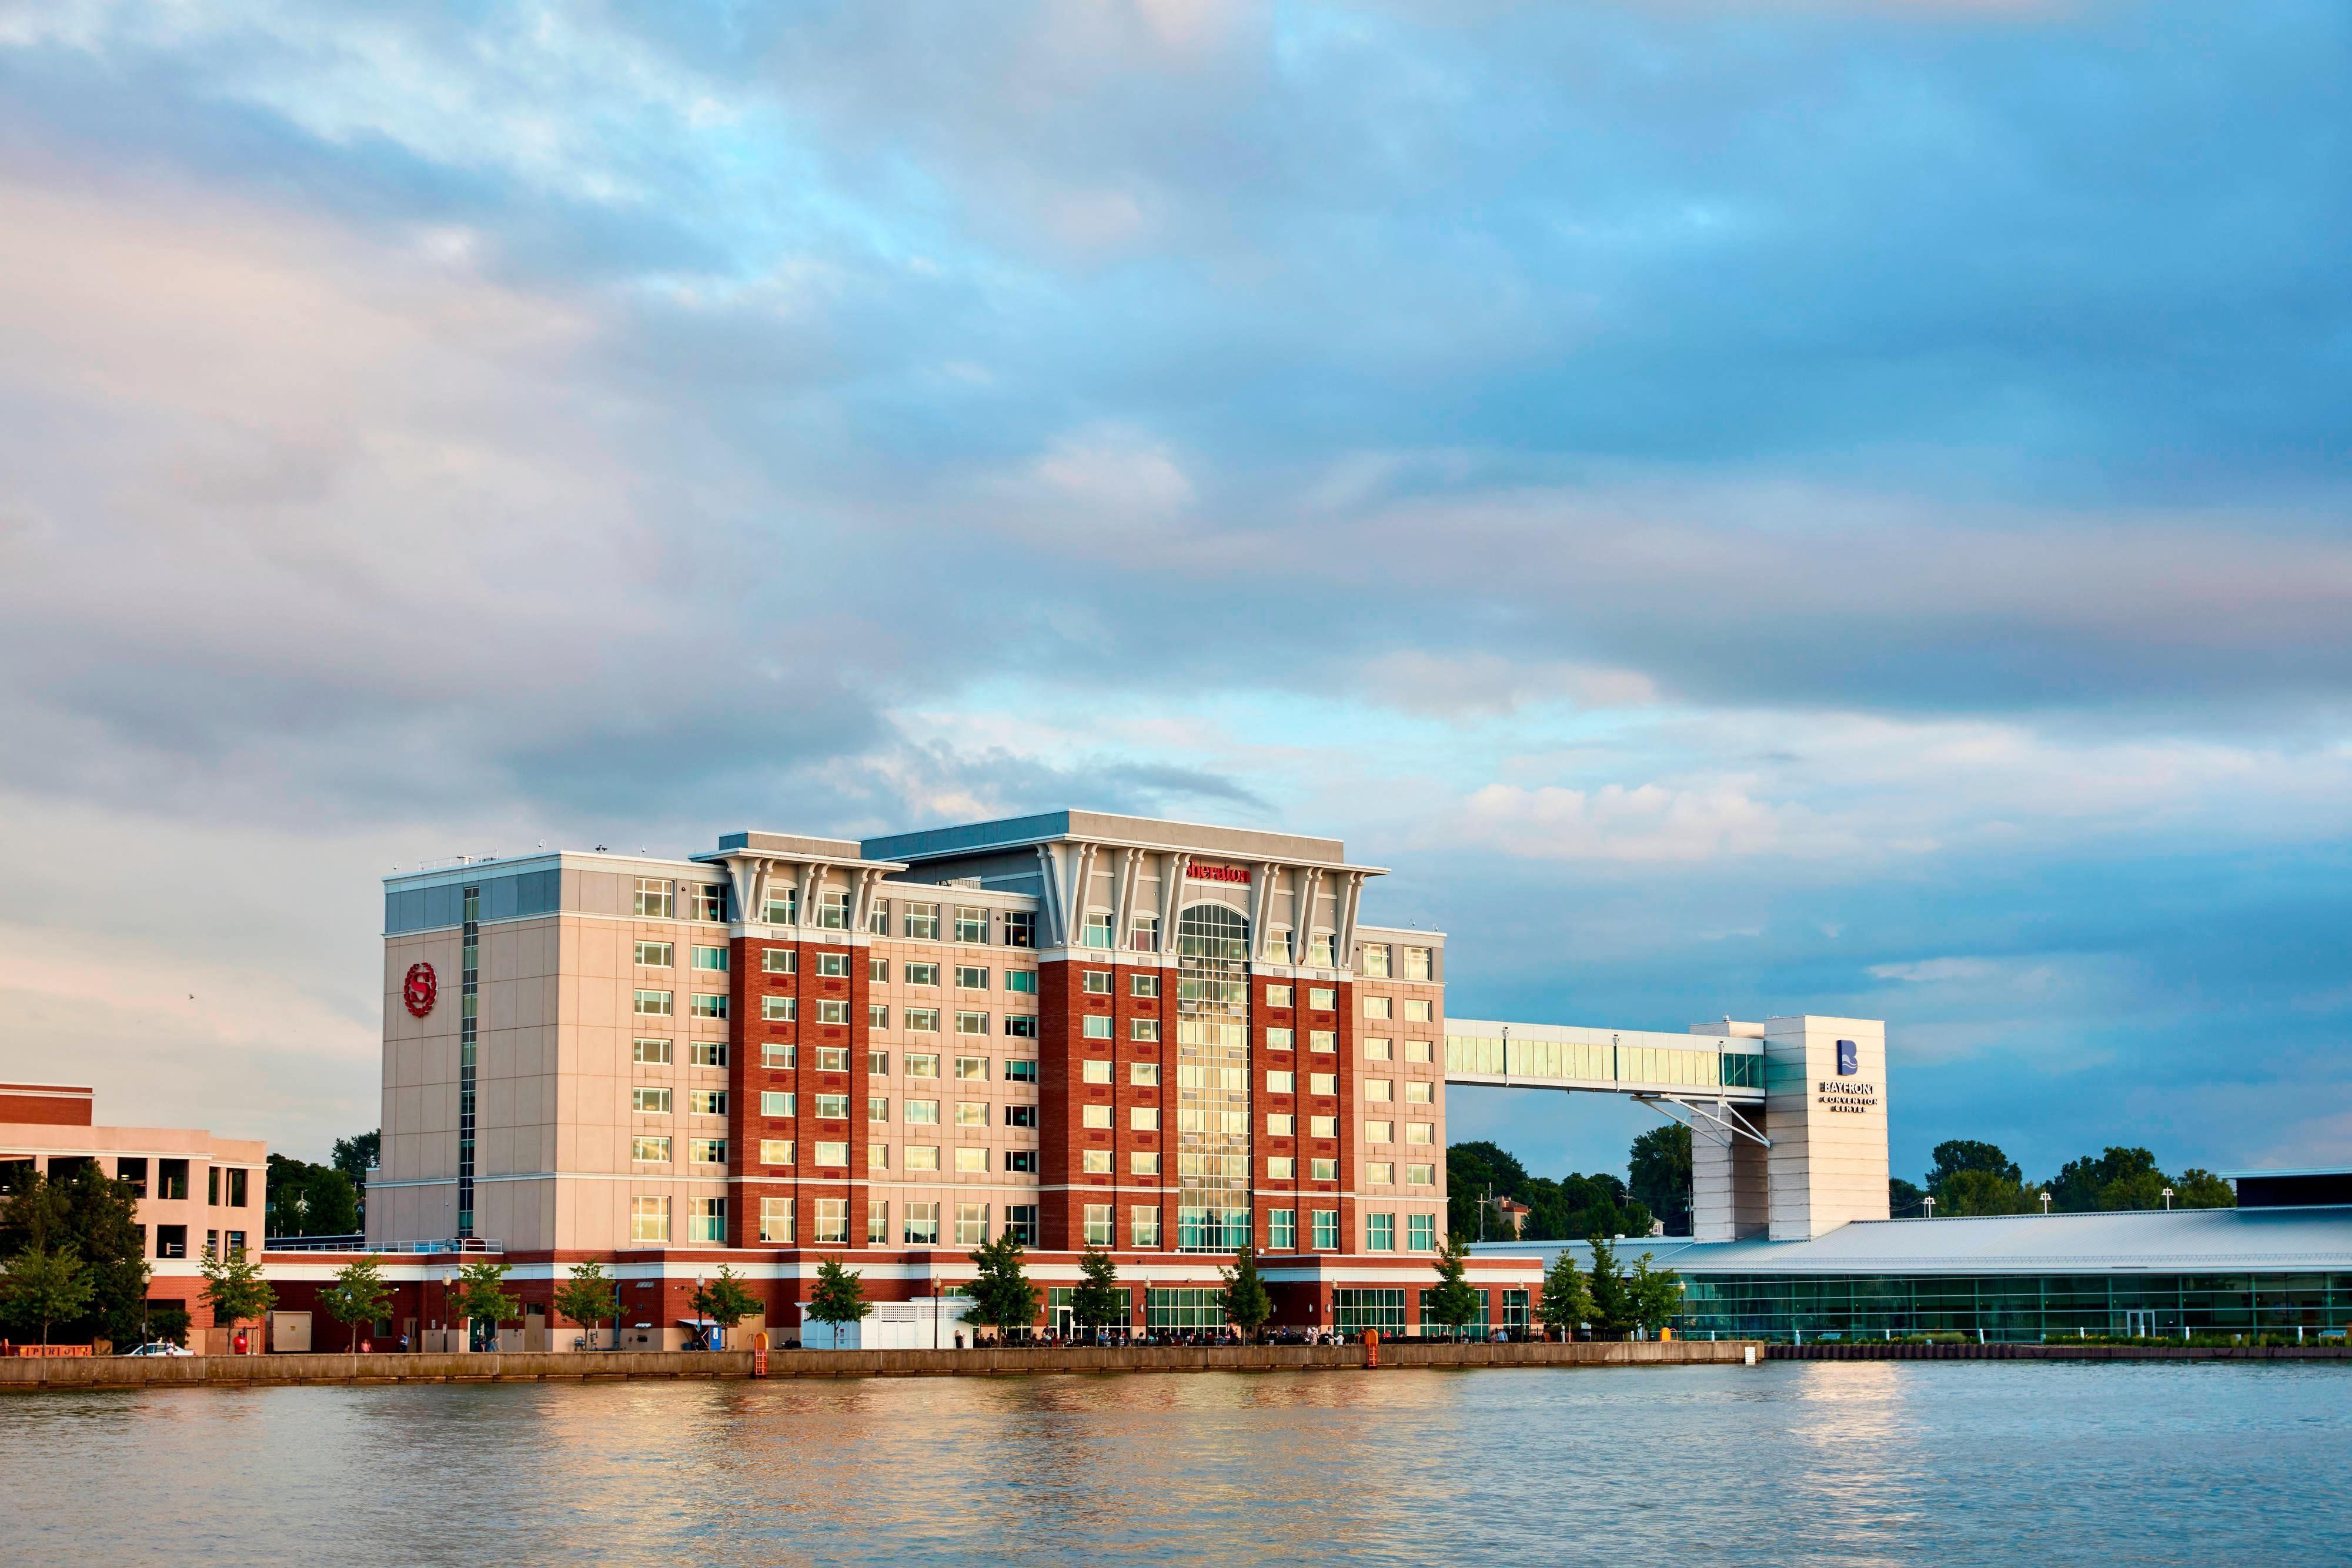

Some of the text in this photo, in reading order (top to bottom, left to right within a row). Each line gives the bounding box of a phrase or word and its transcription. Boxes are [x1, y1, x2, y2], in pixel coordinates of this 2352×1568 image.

[410, 971, 430, 1003] S
[1837, 1039, 1858, 1075] B
[1822, 1082, 1875, 1094] BAYFRONT
[1822, 1096, 1877, 1105] CONVENTION
